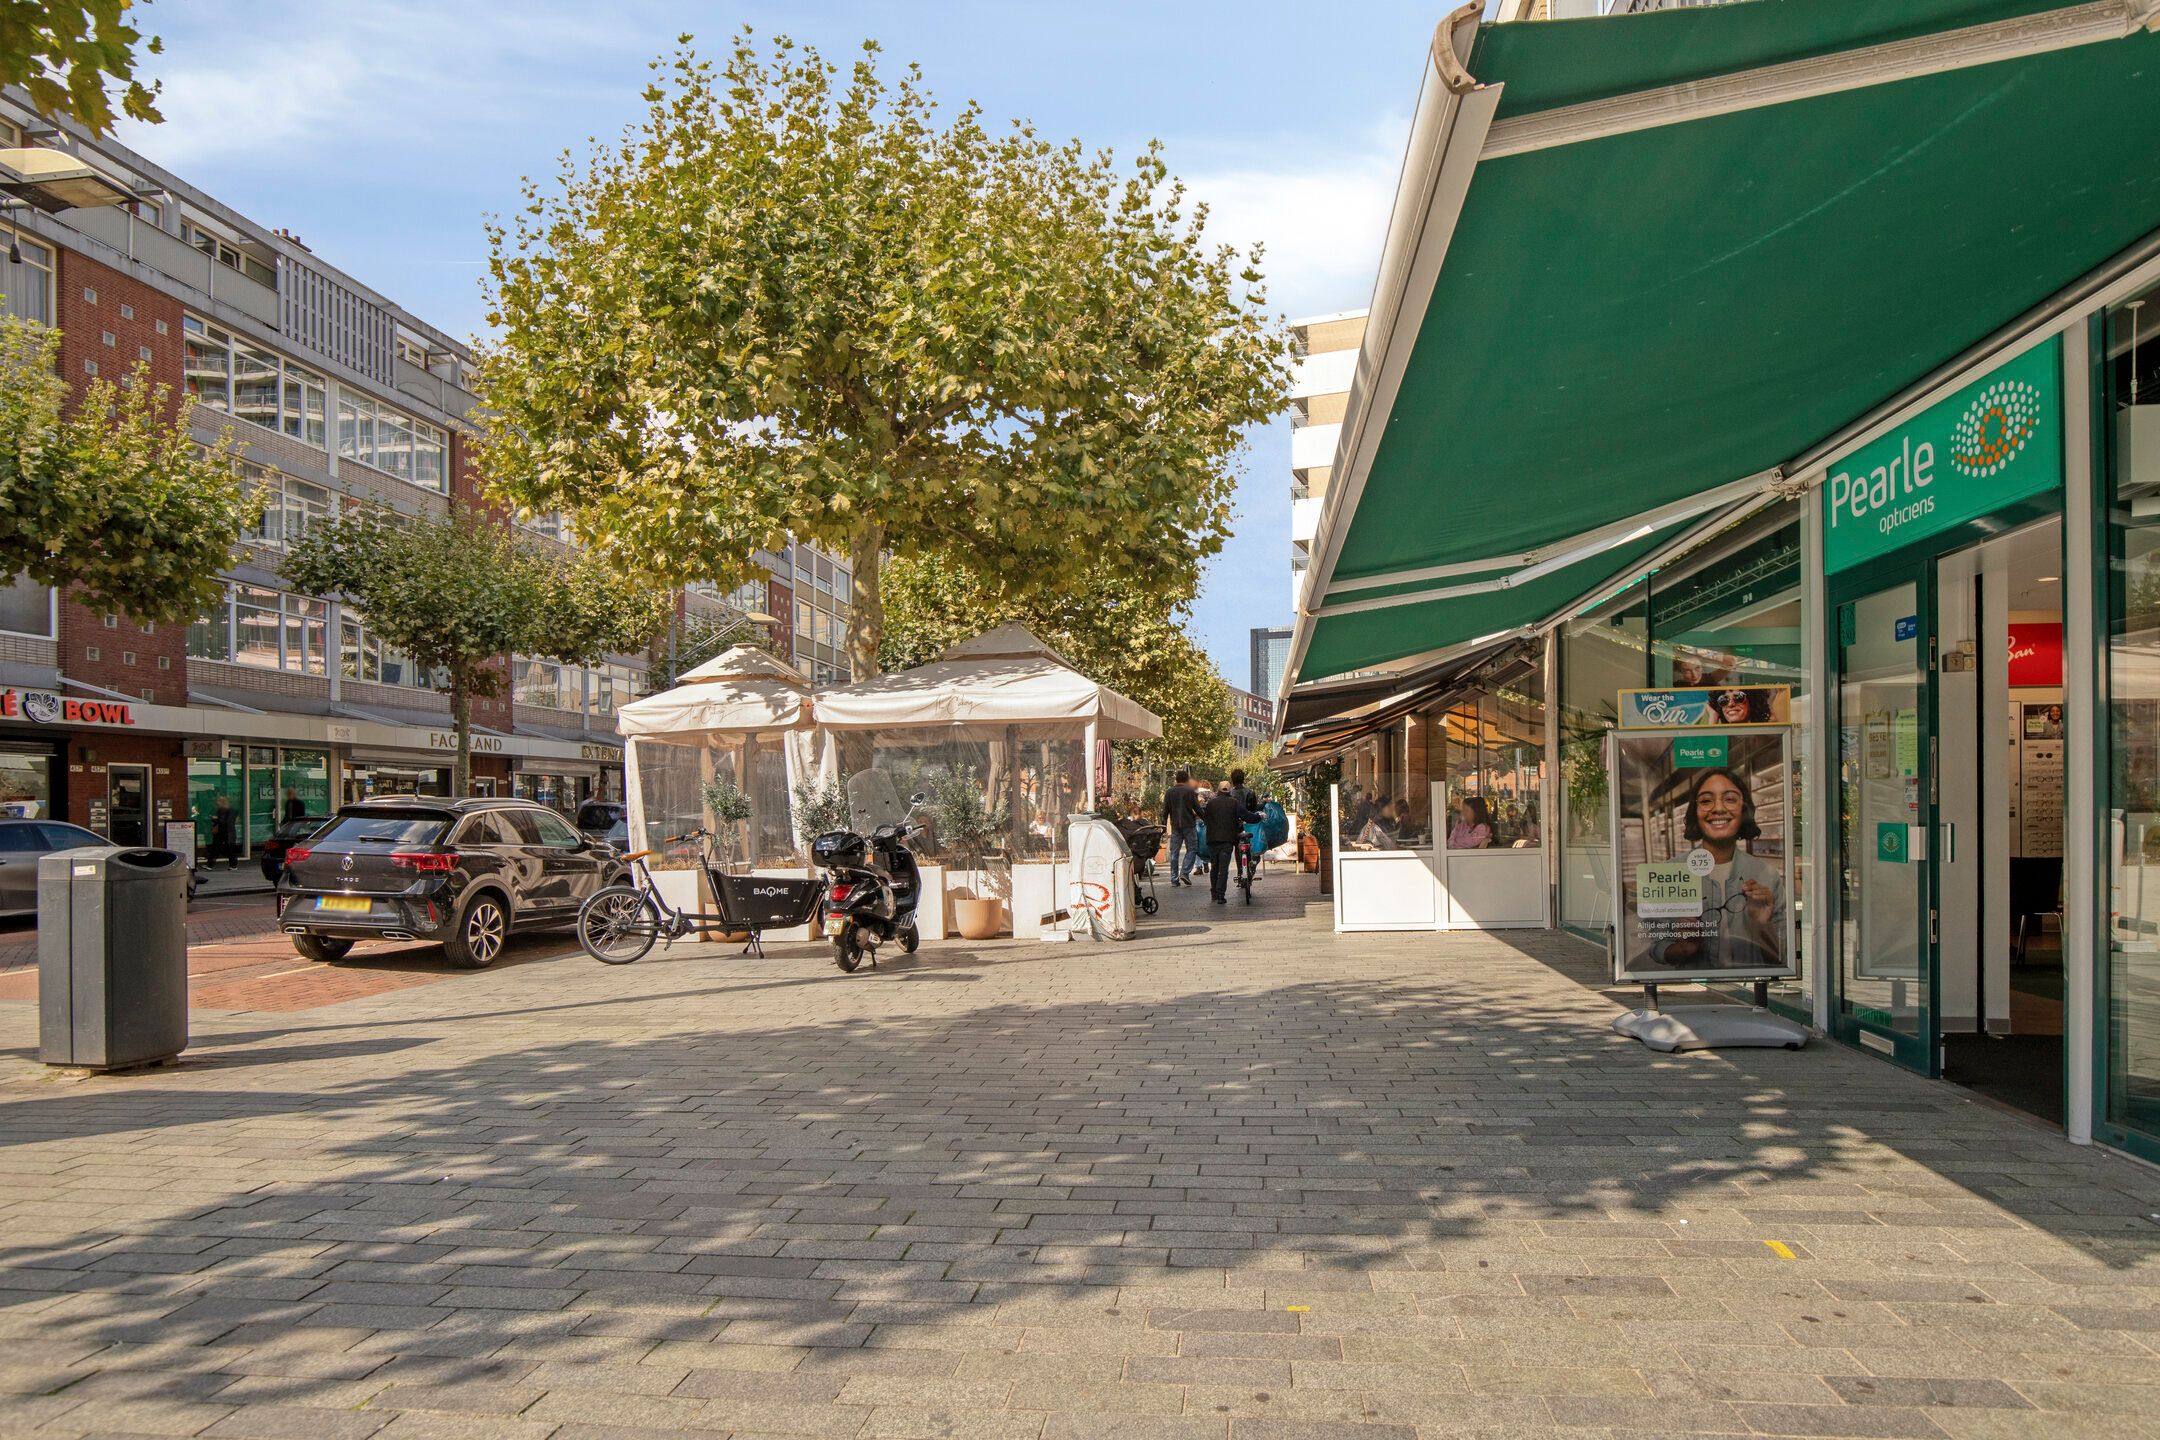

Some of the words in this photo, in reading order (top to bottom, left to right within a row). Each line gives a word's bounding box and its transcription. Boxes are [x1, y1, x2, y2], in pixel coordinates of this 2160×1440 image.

[1831, 436, 1935, 528] Pearle
[1878, 493, 1935, 536] opticiens
[63, 700, 135, 725] BOWL
[1643, 701, 1689, 723] Sun
[1680, 748, 1704, 756] Pearle
[1649, 871, 1690, 883] Pearle
[1643, 887, 1664, 898] Bril
[1669, 887, 1697, 898] Plan
[1637, 922, 1656, 931] Altijd
[1671, 921, 1705, 929] passende
[1648, 931, 1682, 939] zorgeloos
[1682, 930, 1700, 939] goed
